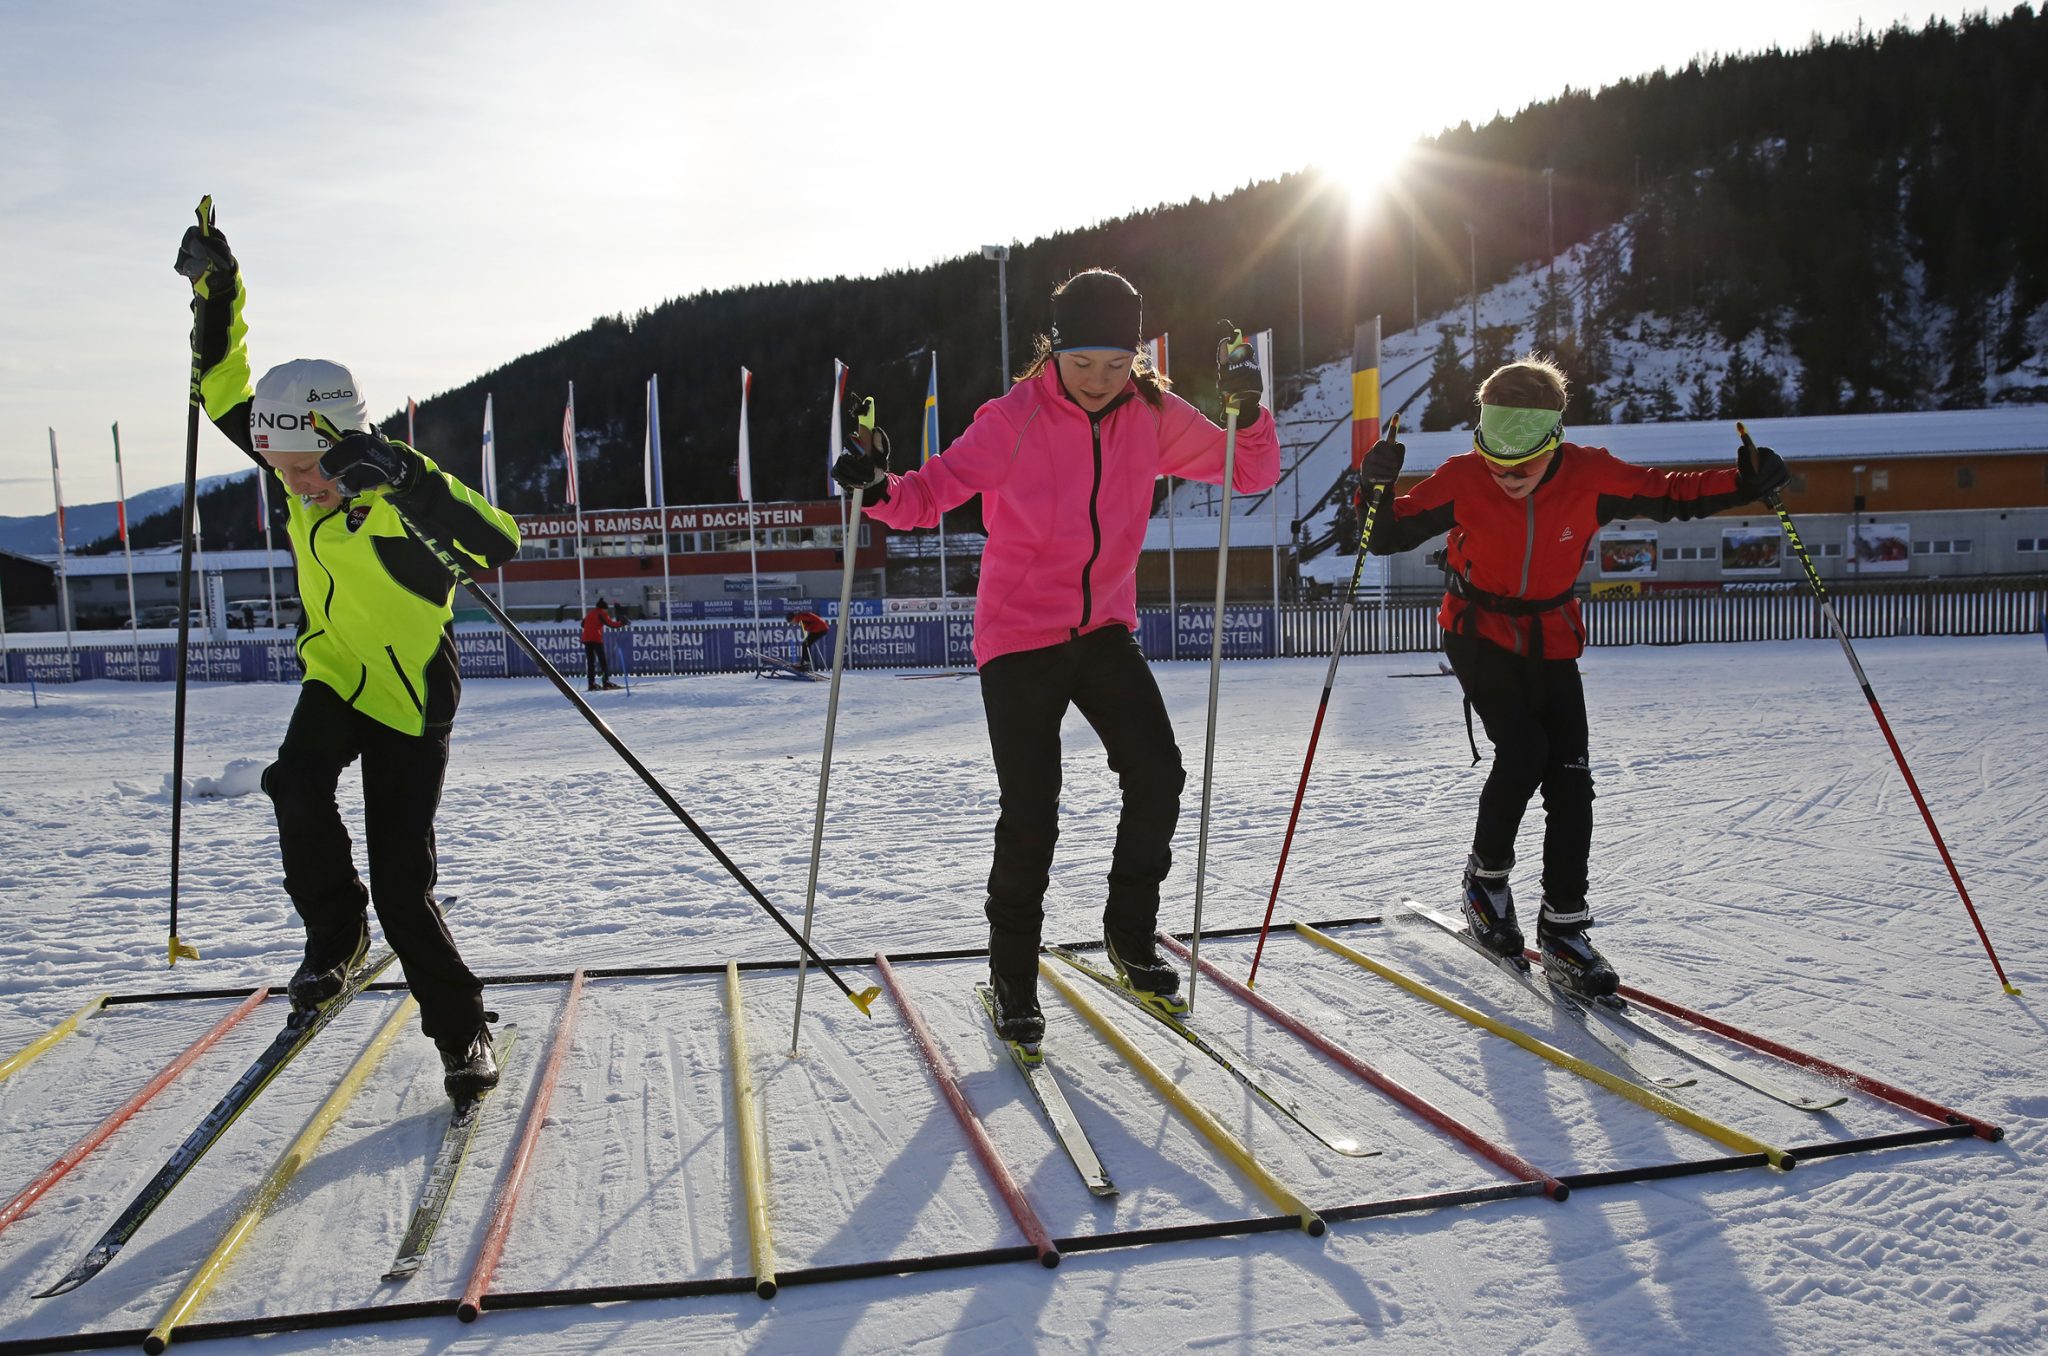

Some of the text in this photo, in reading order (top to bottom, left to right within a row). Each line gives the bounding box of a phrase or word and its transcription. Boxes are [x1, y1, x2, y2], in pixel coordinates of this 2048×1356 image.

[520, 510, 803, 536] STADION RAMSAU AM DACHSTEIN
[1777, 511, 1803, 550] LEKI
[424, 537, 474, 586] LEKI
[632, 632, 704, 647] RAMSAU
[852, 625, 916, 640] AMSAU
[456, 639, 505, 653] AMSAU
[537, 636, 585, 650] RAMS
[633, 648, 704, 662] DACHSTEIN
[734, 646, 803, 659] DACHSTEI
[460, 655, 506, 666] CHSTEIN
[26, 668, 81, 678] DACHSTEN
[1547, 952, 1585, 978] ALOMON
[314, 983, 360, 1035] FISCHER
[117, 1188, 166, 1242] FISCHER
